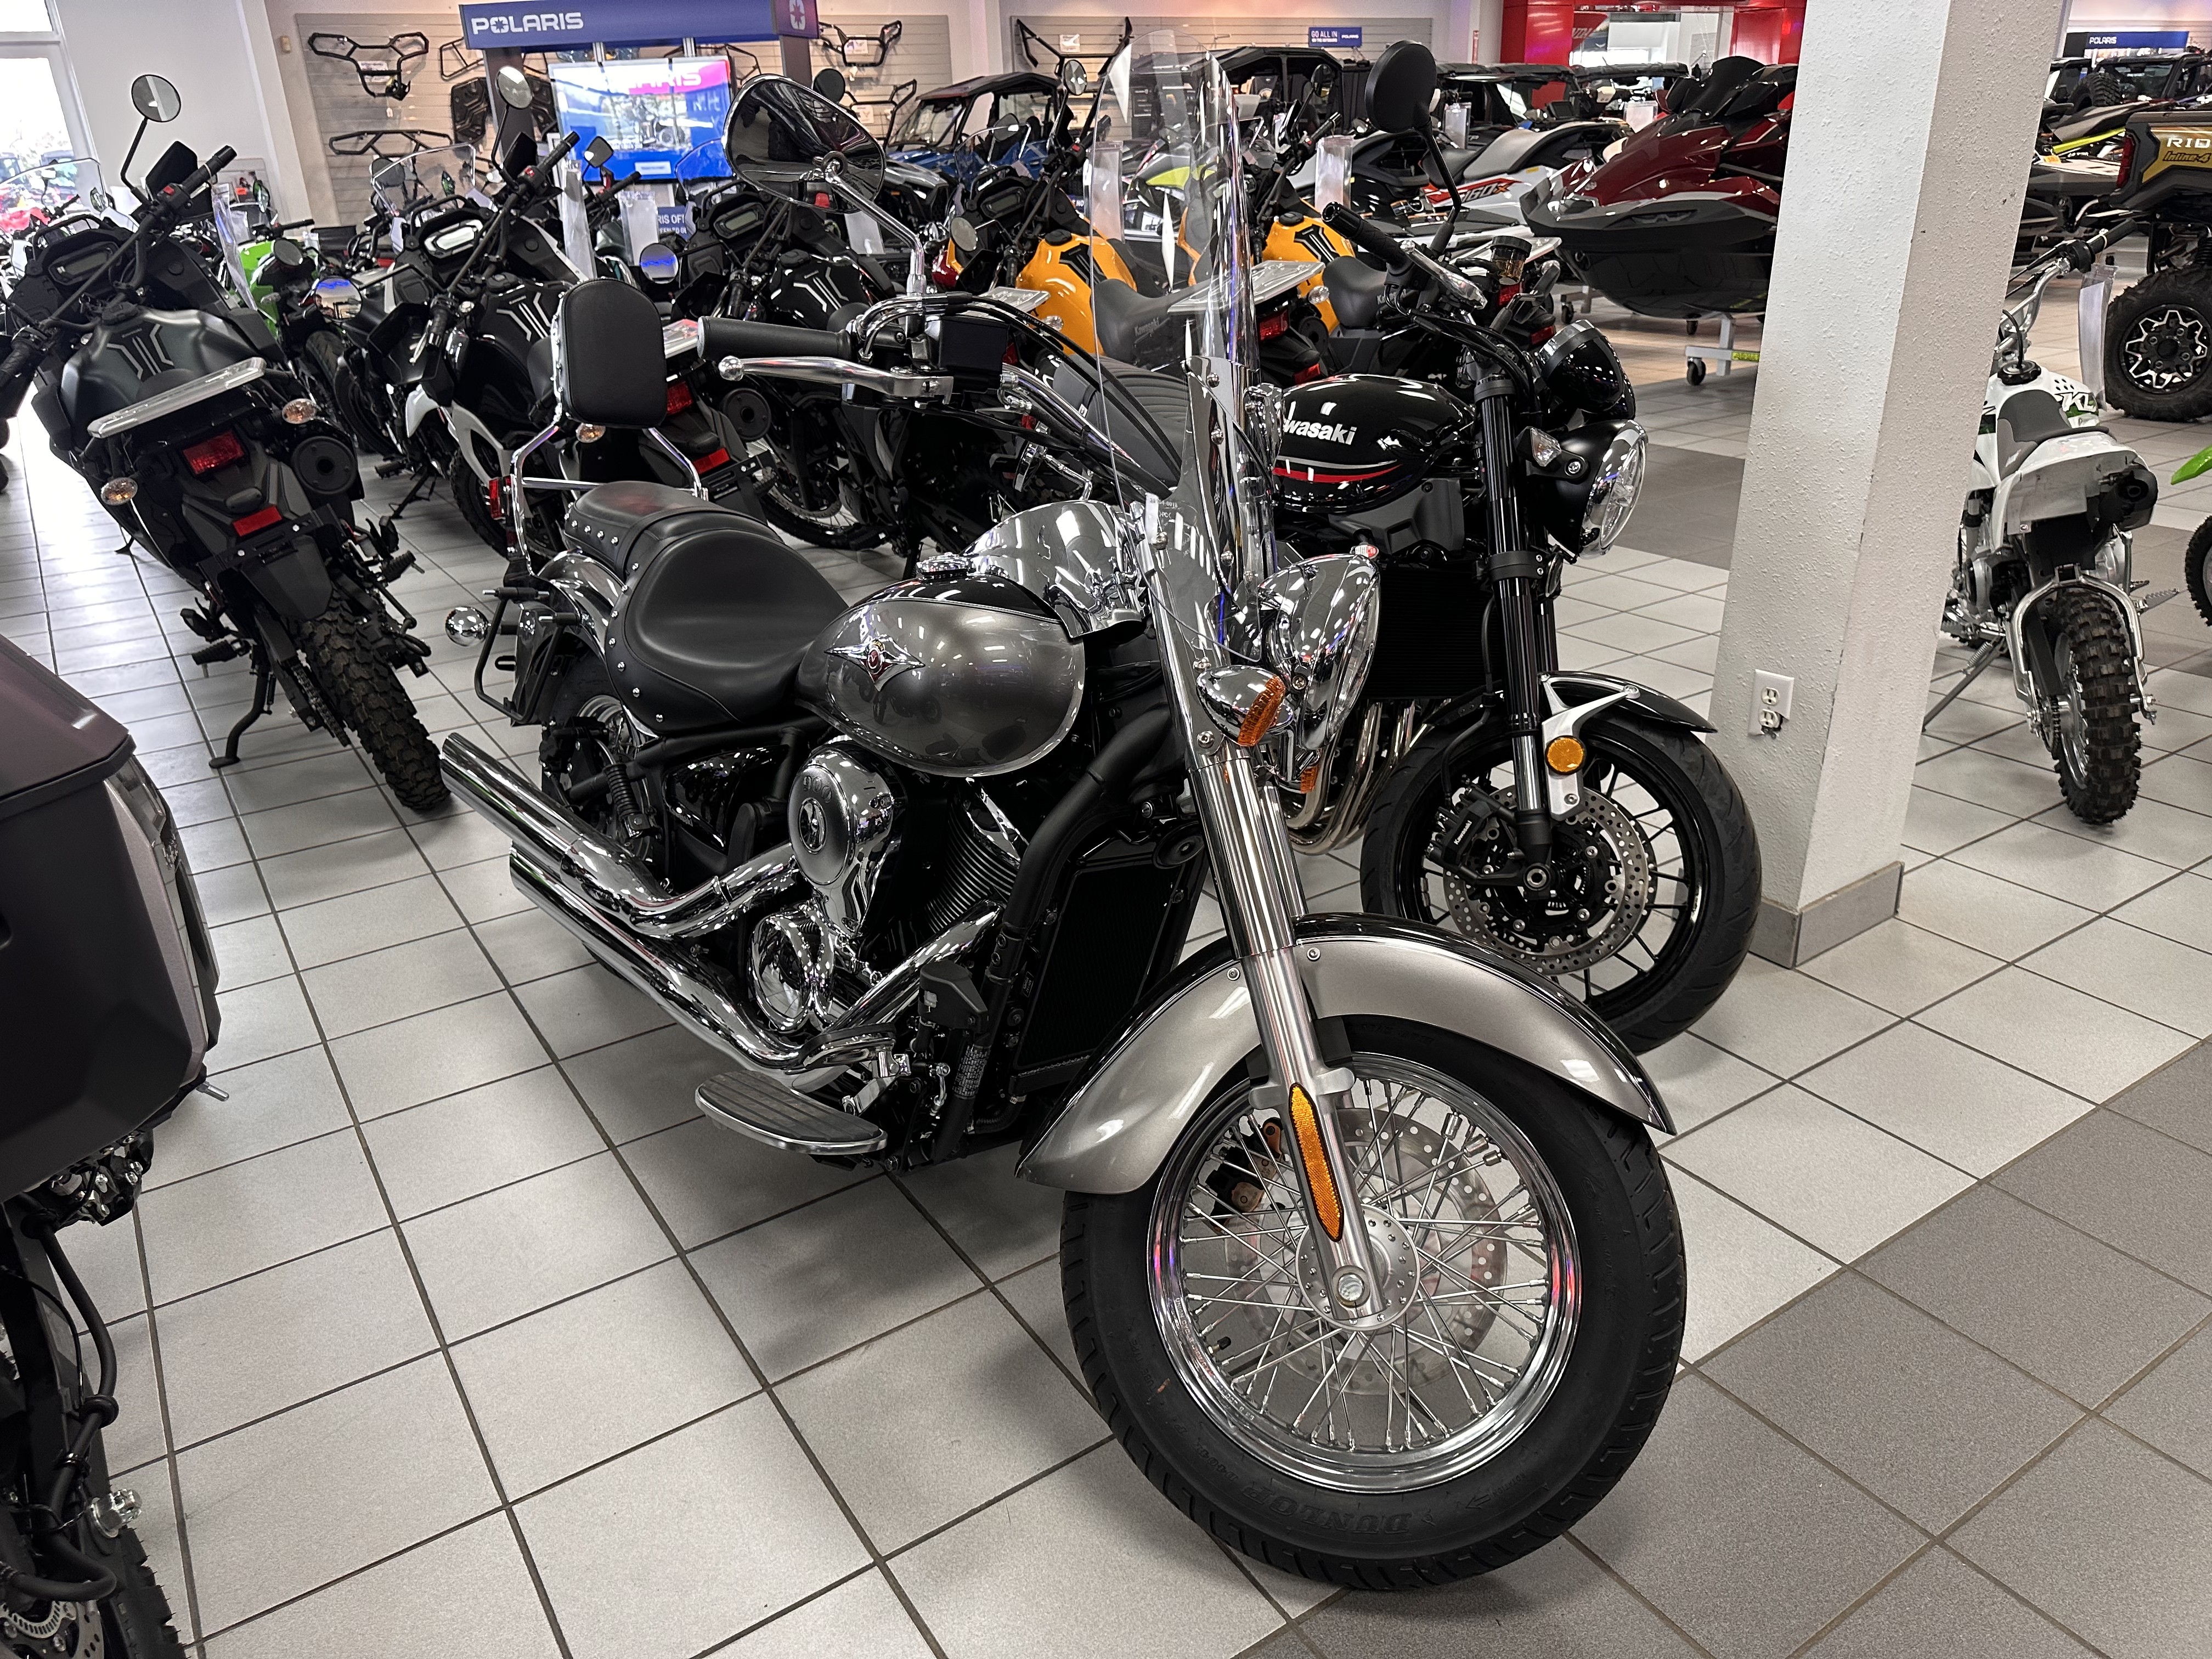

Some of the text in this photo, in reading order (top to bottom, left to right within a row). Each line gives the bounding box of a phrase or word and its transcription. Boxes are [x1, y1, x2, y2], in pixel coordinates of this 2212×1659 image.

[470, 12, 584, 35] POLARIS
[2089, 36, 2117, 44] POLARIS
[1284, 419, 1358, 446] wasaki
[803, 775, 832, 804] 900
[1454, 820, 1472, 845] Kawasaki
[1242, 1486, 1413, 1534] DUNLOP
